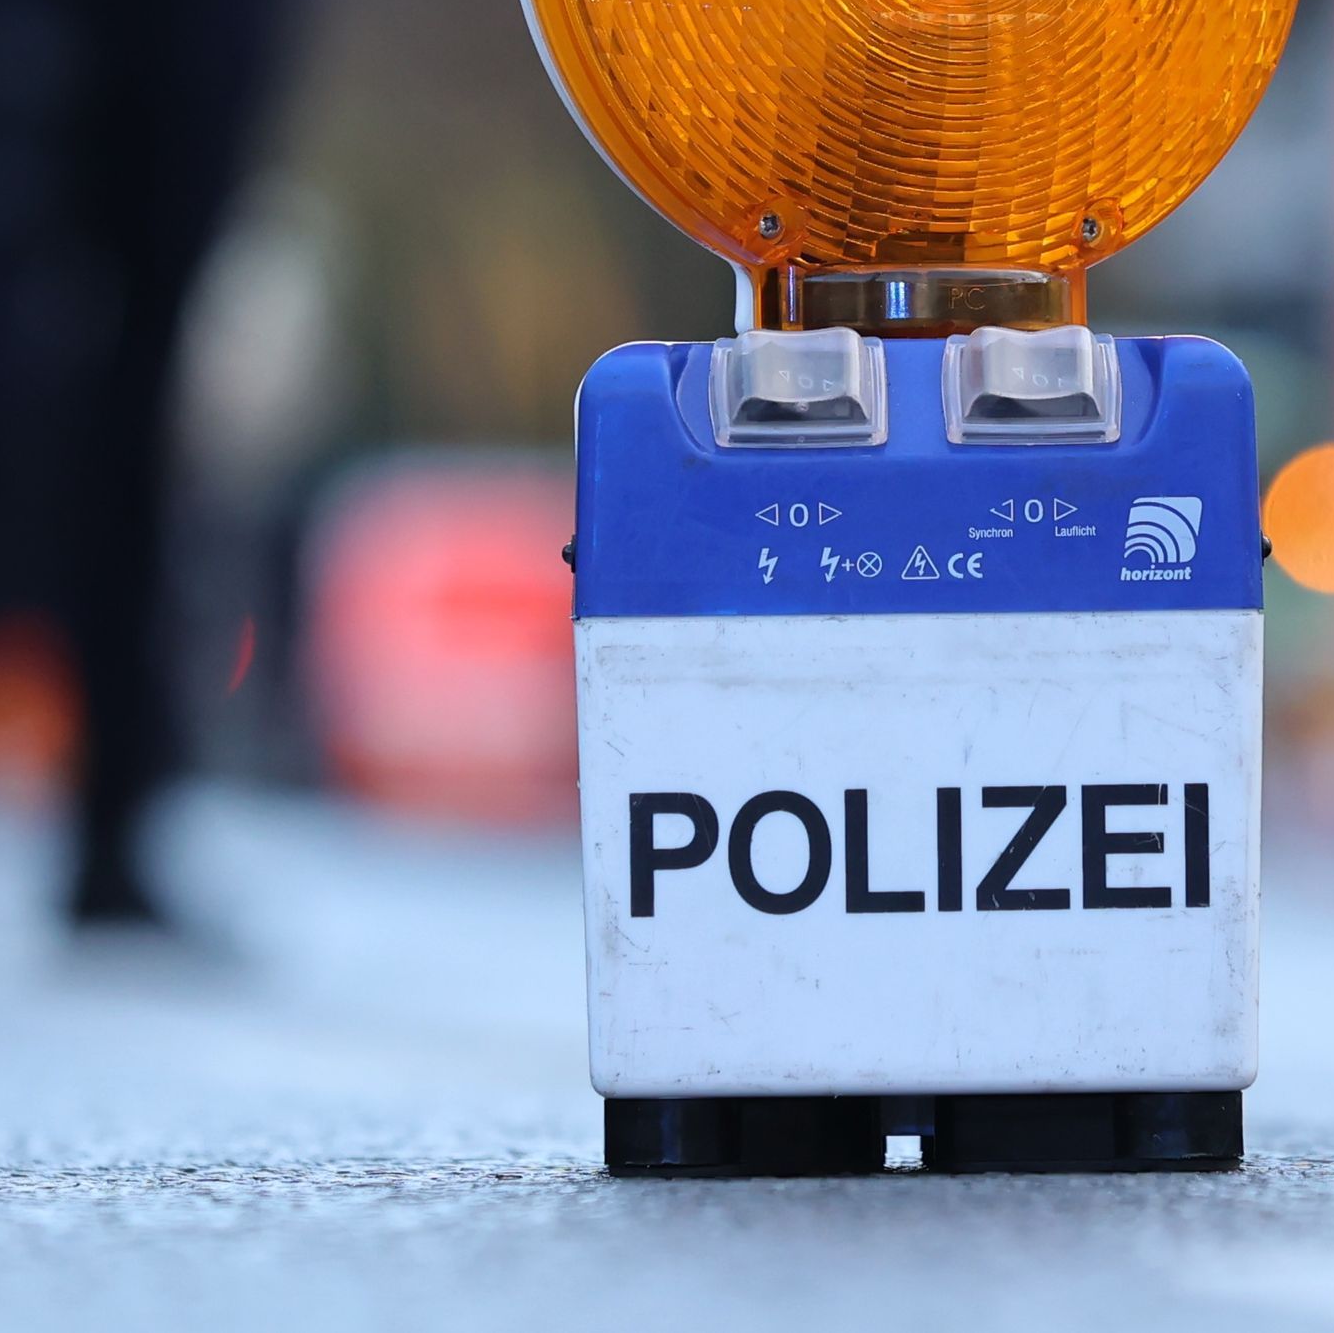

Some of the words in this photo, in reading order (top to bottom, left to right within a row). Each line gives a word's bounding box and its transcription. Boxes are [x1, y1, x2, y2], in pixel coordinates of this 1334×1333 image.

[948, 286, 986, 310] PC
[789, 503, 809, 527] 0
[1024, 499, 1044, 523] 0
[968, 526, 1014, 541] Synchron
[1054, 525, 1097, 537] Lauflicht
[947, 552, 984, 579] CE
[1120, 564, 1192, 581] horizont
[628, 782, 1211, 918] POLIZEI
